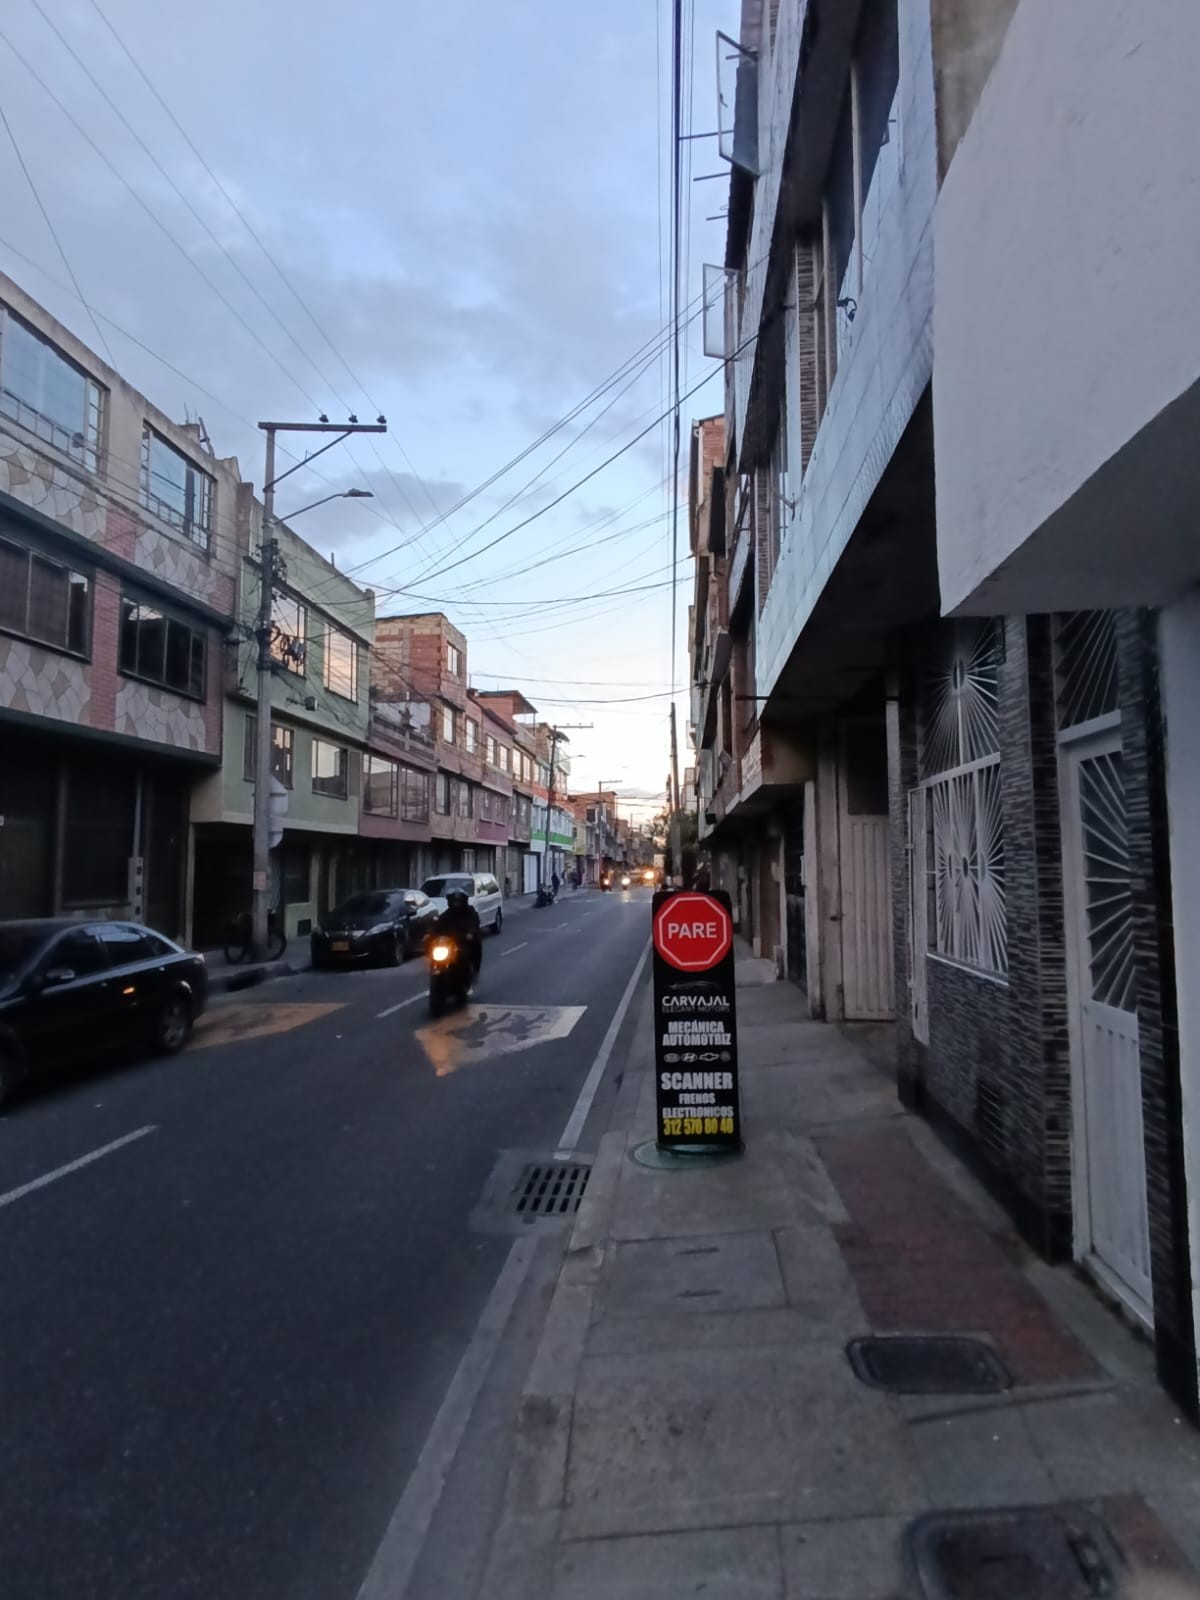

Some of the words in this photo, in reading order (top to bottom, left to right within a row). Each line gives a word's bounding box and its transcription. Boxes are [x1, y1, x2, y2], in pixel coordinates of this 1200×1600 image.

[668, 922, 717, 939] PARE
[662, 995, 730, 1006] CARVAJAL
[668, 1019, 724, 1033] MECÁNICA
[662, 1033, 731, 1046] AUTOMOTRIZ
[661, 1072, 733, 1090] SCANNER
[678, 1093, 716, 1105] FRENOS
[662, 1106, 734, 1118] ELECTRONICOS
[663, 1118, 682, 1136] 312
